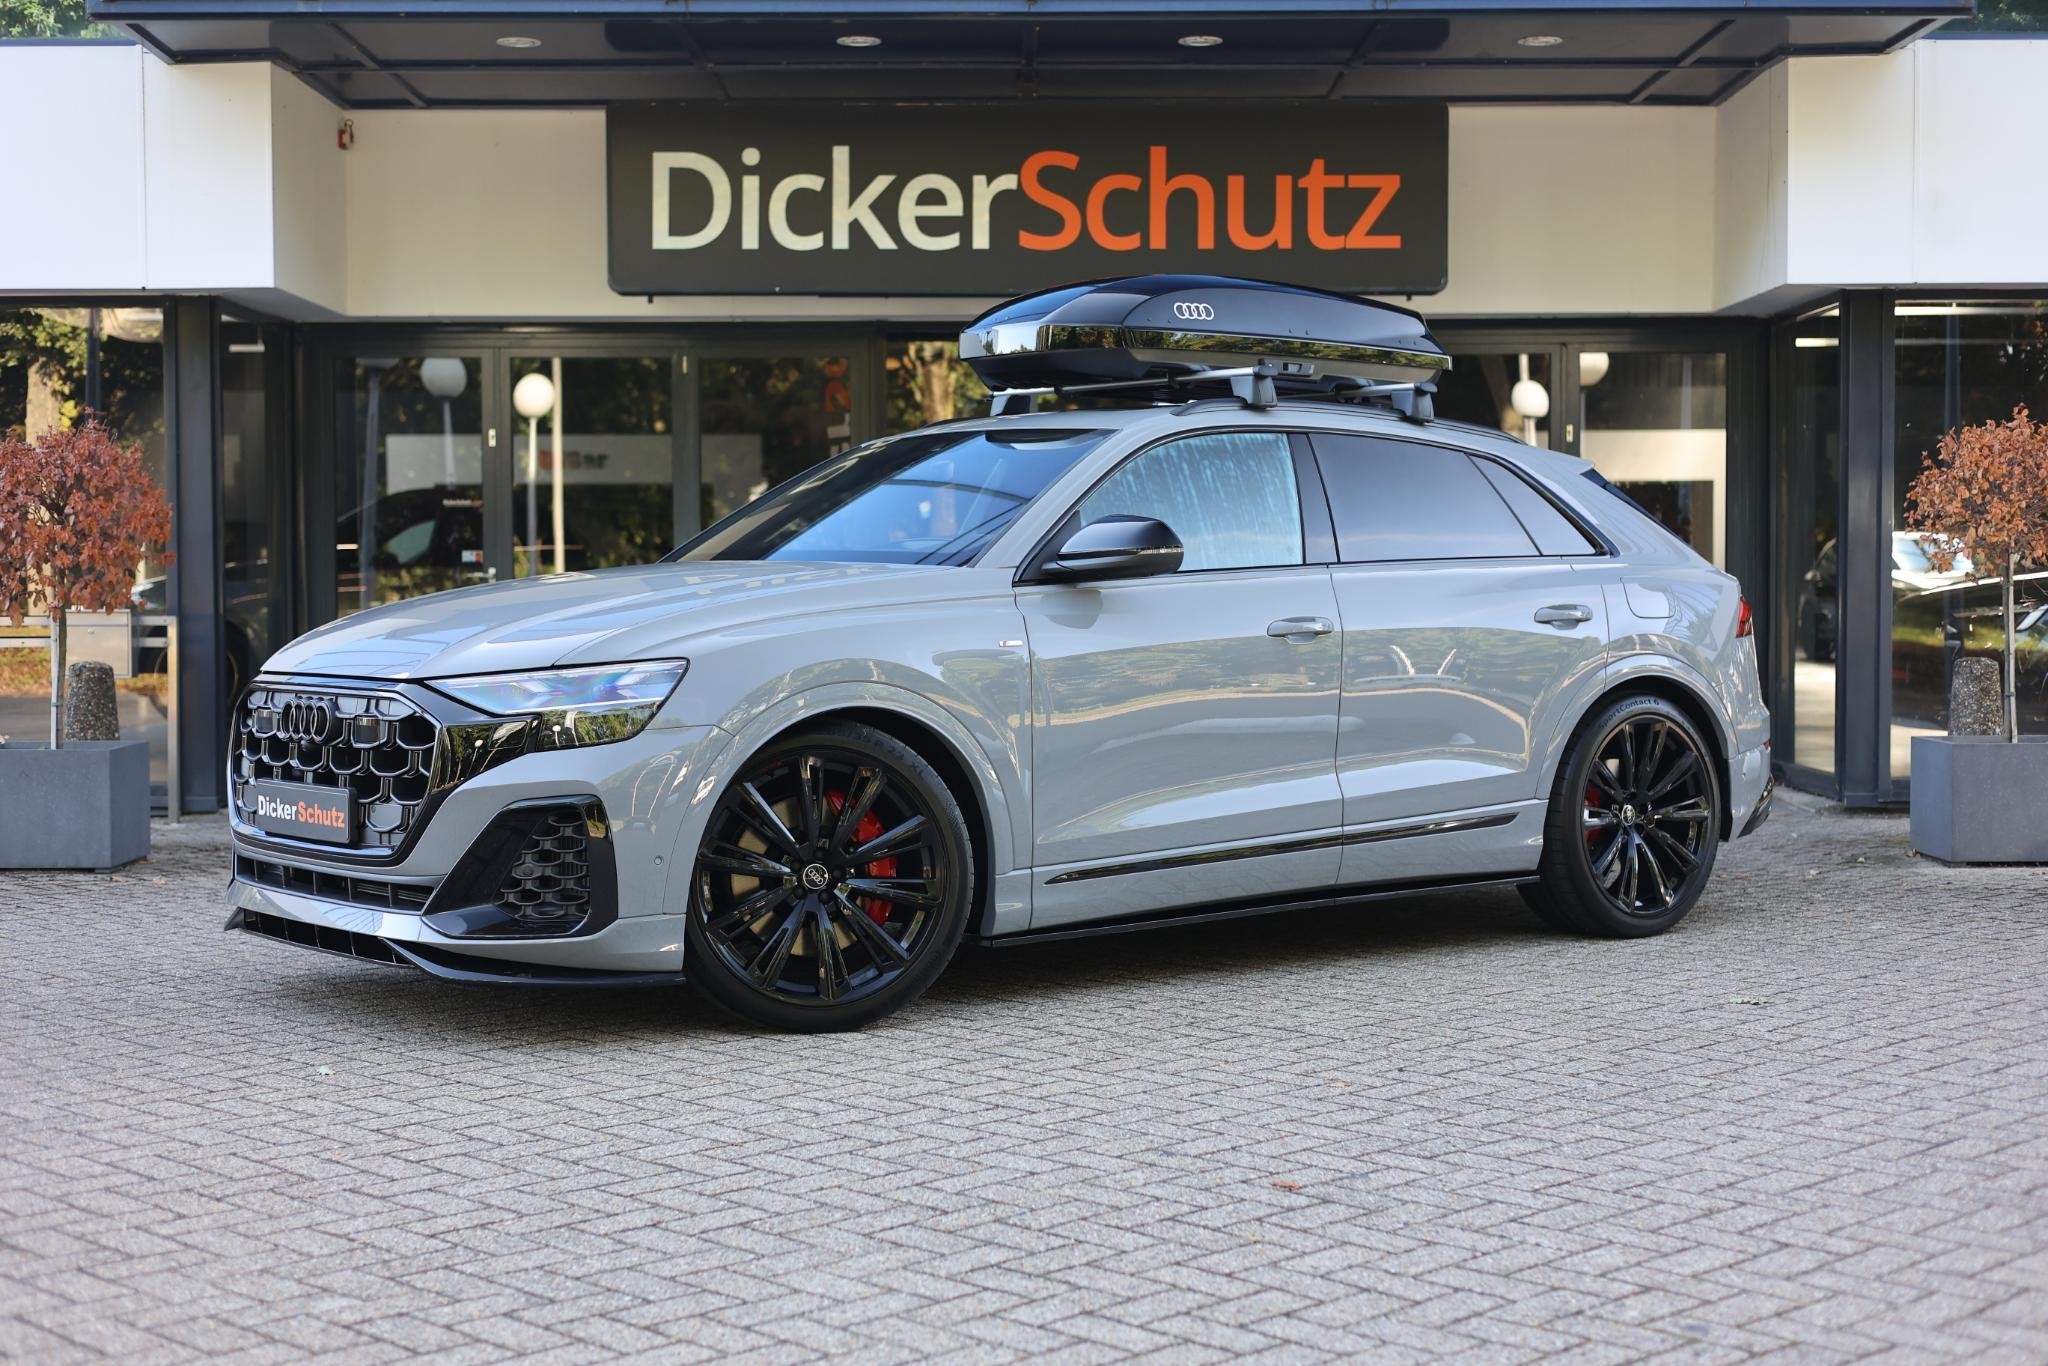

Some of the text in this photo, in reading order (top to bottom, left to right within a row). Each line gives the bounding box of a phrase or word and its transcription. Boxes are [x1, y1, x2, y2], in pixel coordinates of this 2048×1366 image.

[651, 145, 1401, 251] DickerSchutz
[1599, 698, 1651, 729] SportContact
[257, 794, 345, 829] DickerSchutz
